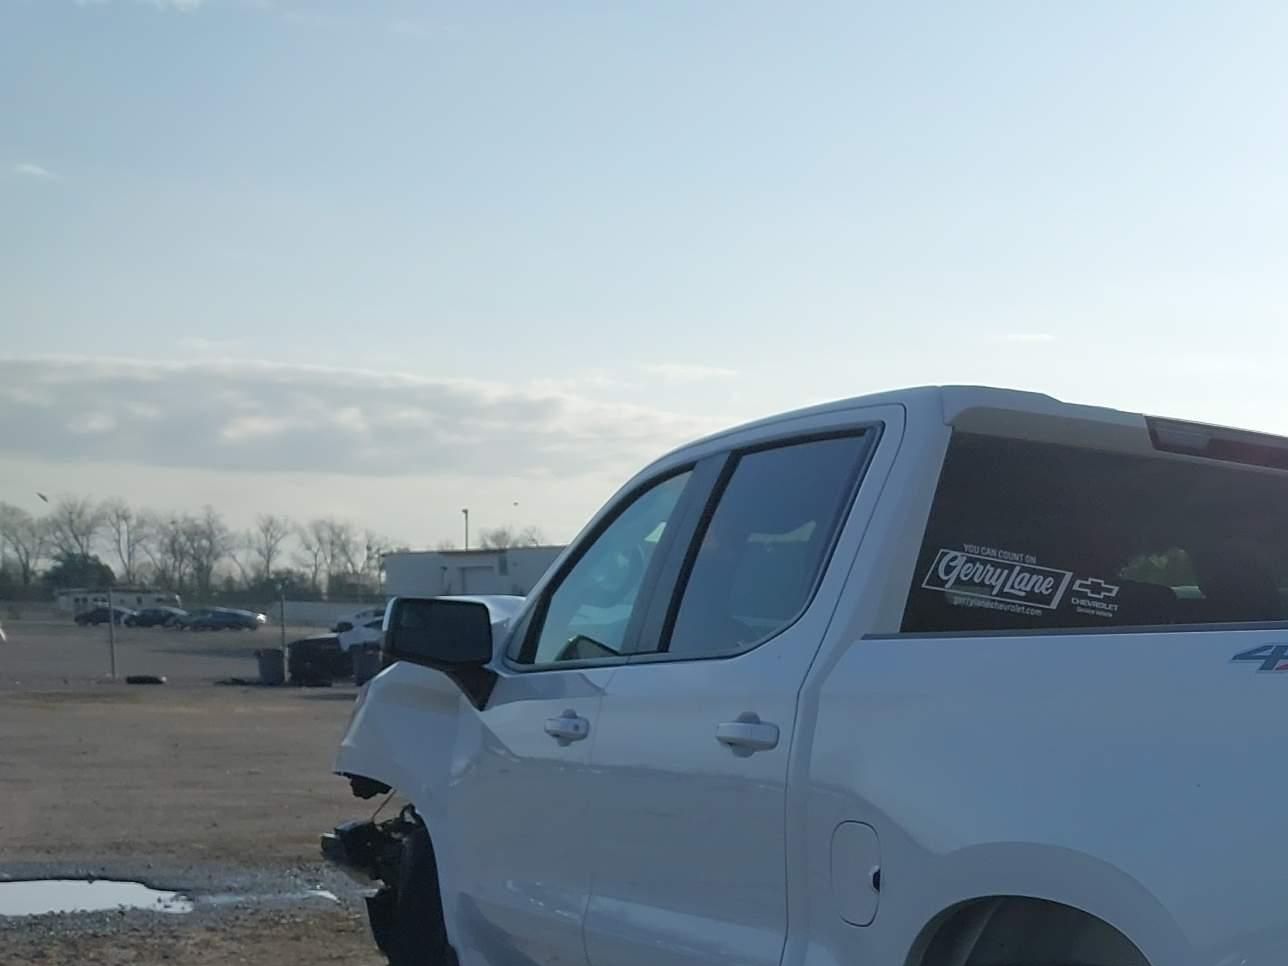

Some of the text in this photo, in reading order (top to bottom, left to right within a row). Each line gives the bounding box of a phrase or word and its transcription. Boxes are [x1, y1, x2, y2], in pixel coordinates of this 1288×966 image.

[963, 543, 980, 554] YOU
[981, 546, 997, 557] CAN
[999, 549, 1023, 561] COUNT
[938, 552, 1053, 597] Gerry Lane
